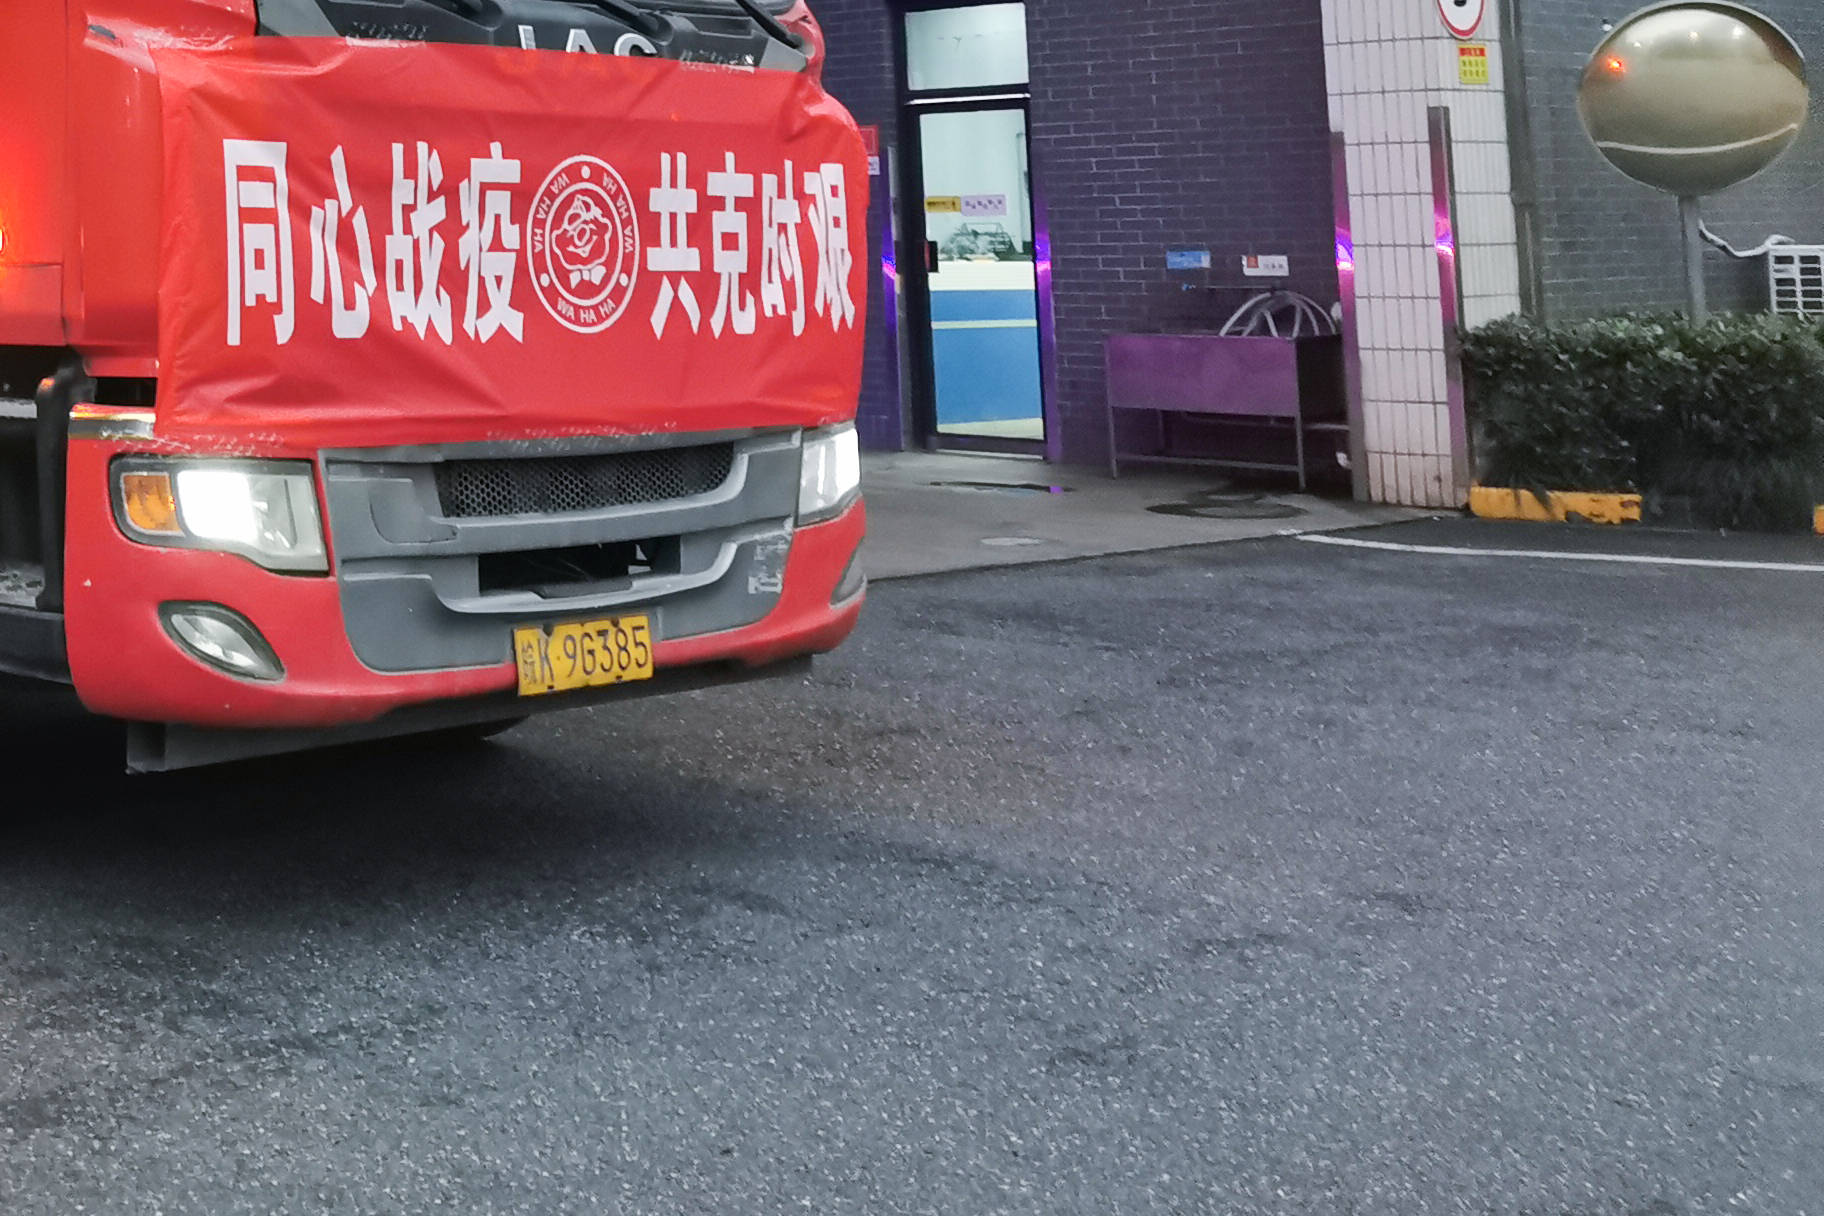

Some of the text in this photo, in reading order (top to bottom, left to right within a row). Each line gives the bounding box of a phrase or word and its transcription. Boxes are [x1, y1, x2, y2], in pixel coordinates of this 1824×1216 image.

[223, 138, 856, 346] 同心战疫 共克时艰
[533, 173, 570, 253] WA HA HA
[602, 172, 634, 253] WA HA HA
[557, 297, 617, 323] WA HA HA
